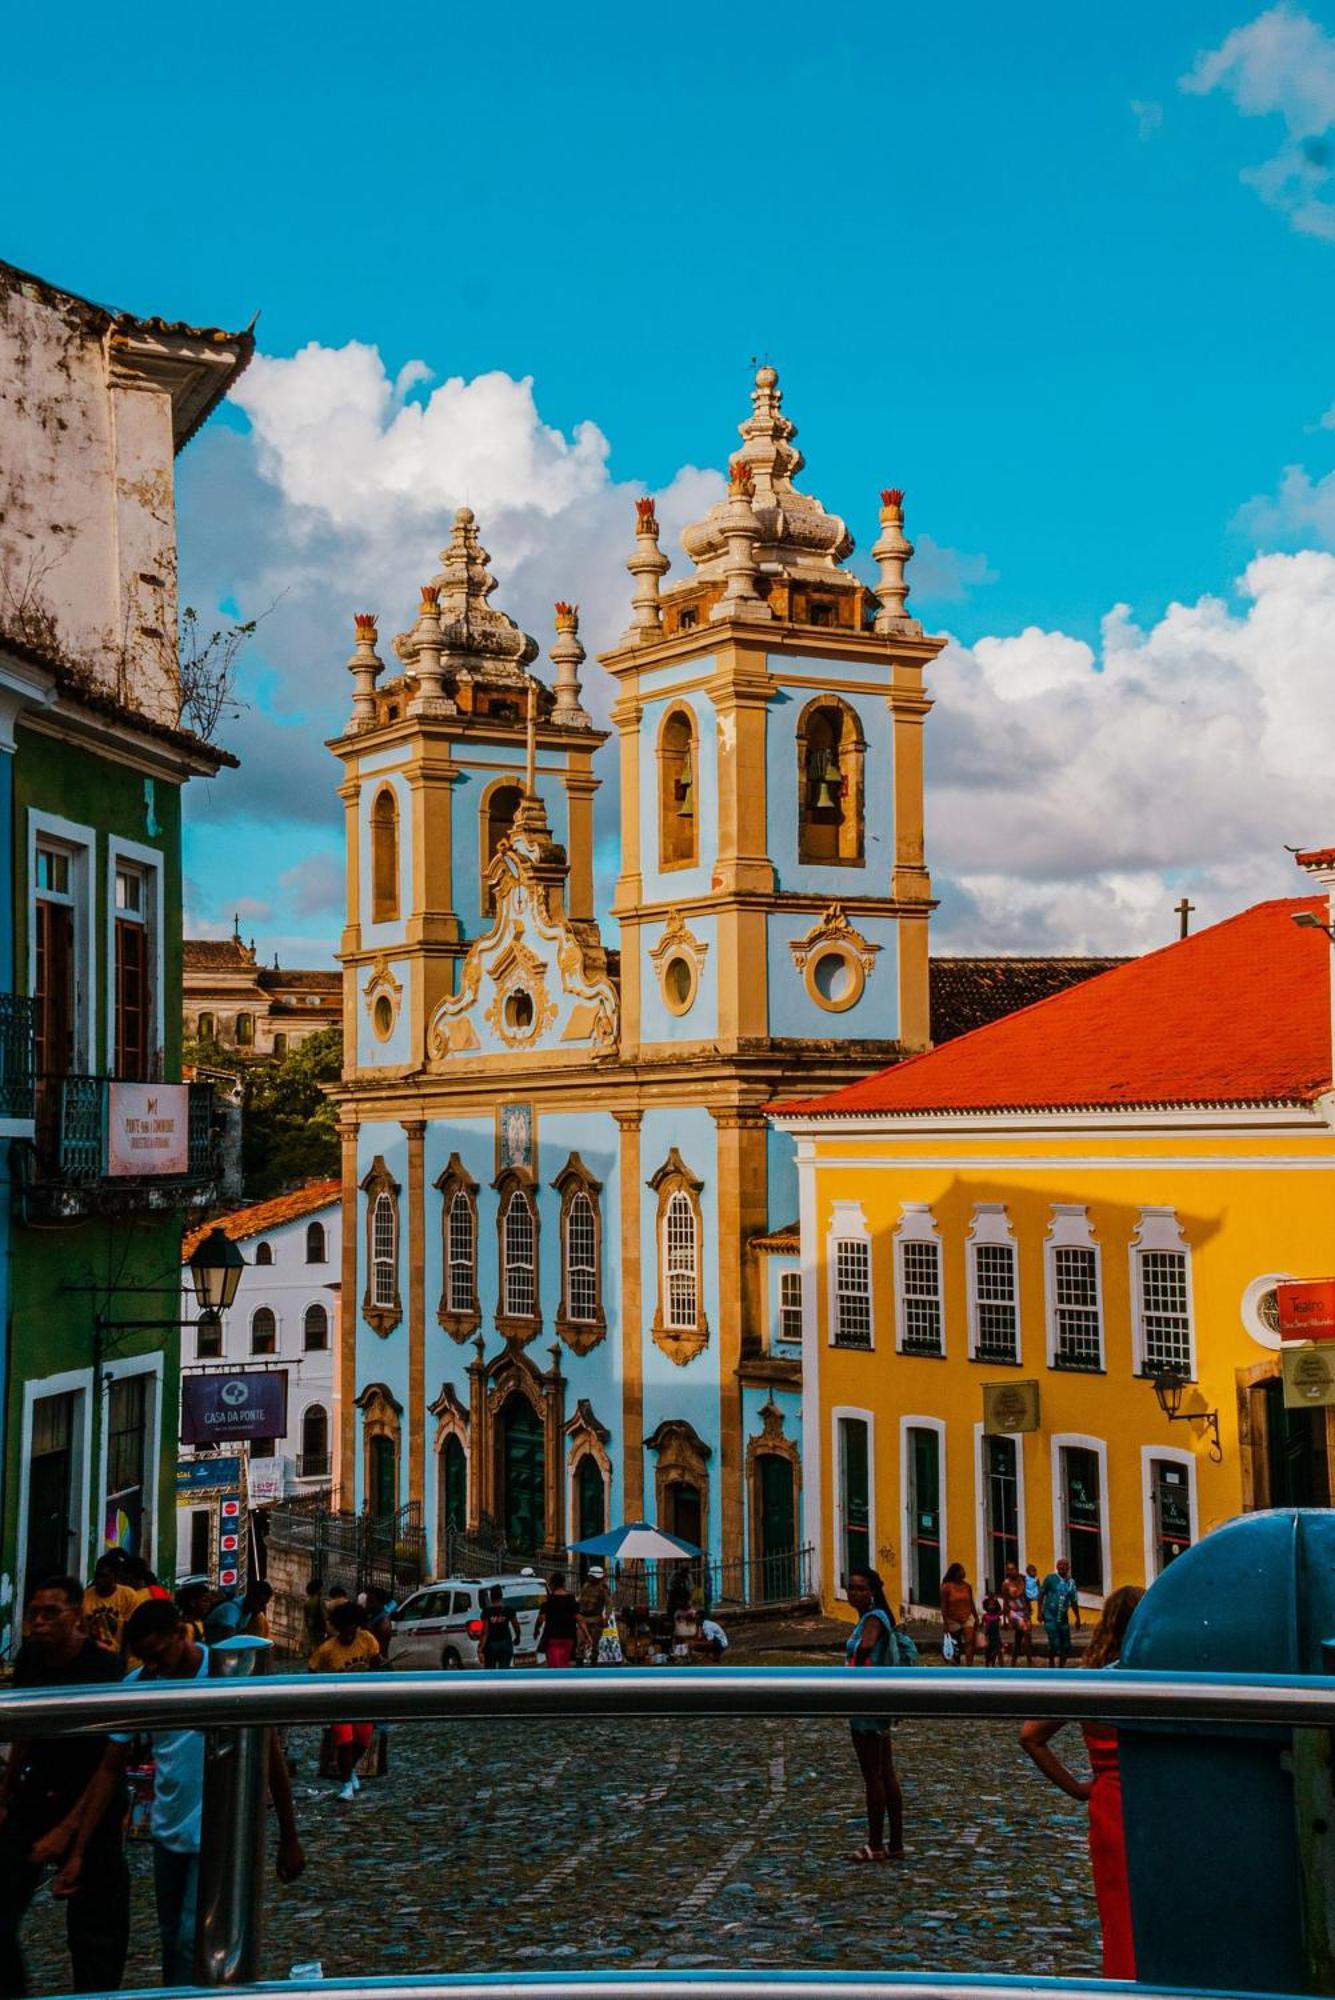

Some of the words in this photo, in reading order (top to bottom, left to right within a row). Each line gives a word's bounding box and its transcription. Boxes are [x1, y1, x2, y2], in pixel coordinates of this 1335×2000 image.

[1288, 1296, 1324, 1313] Teatro
[204, 1411, 226, 1425] CASA
[227, 1410, 238, 1423] DA
